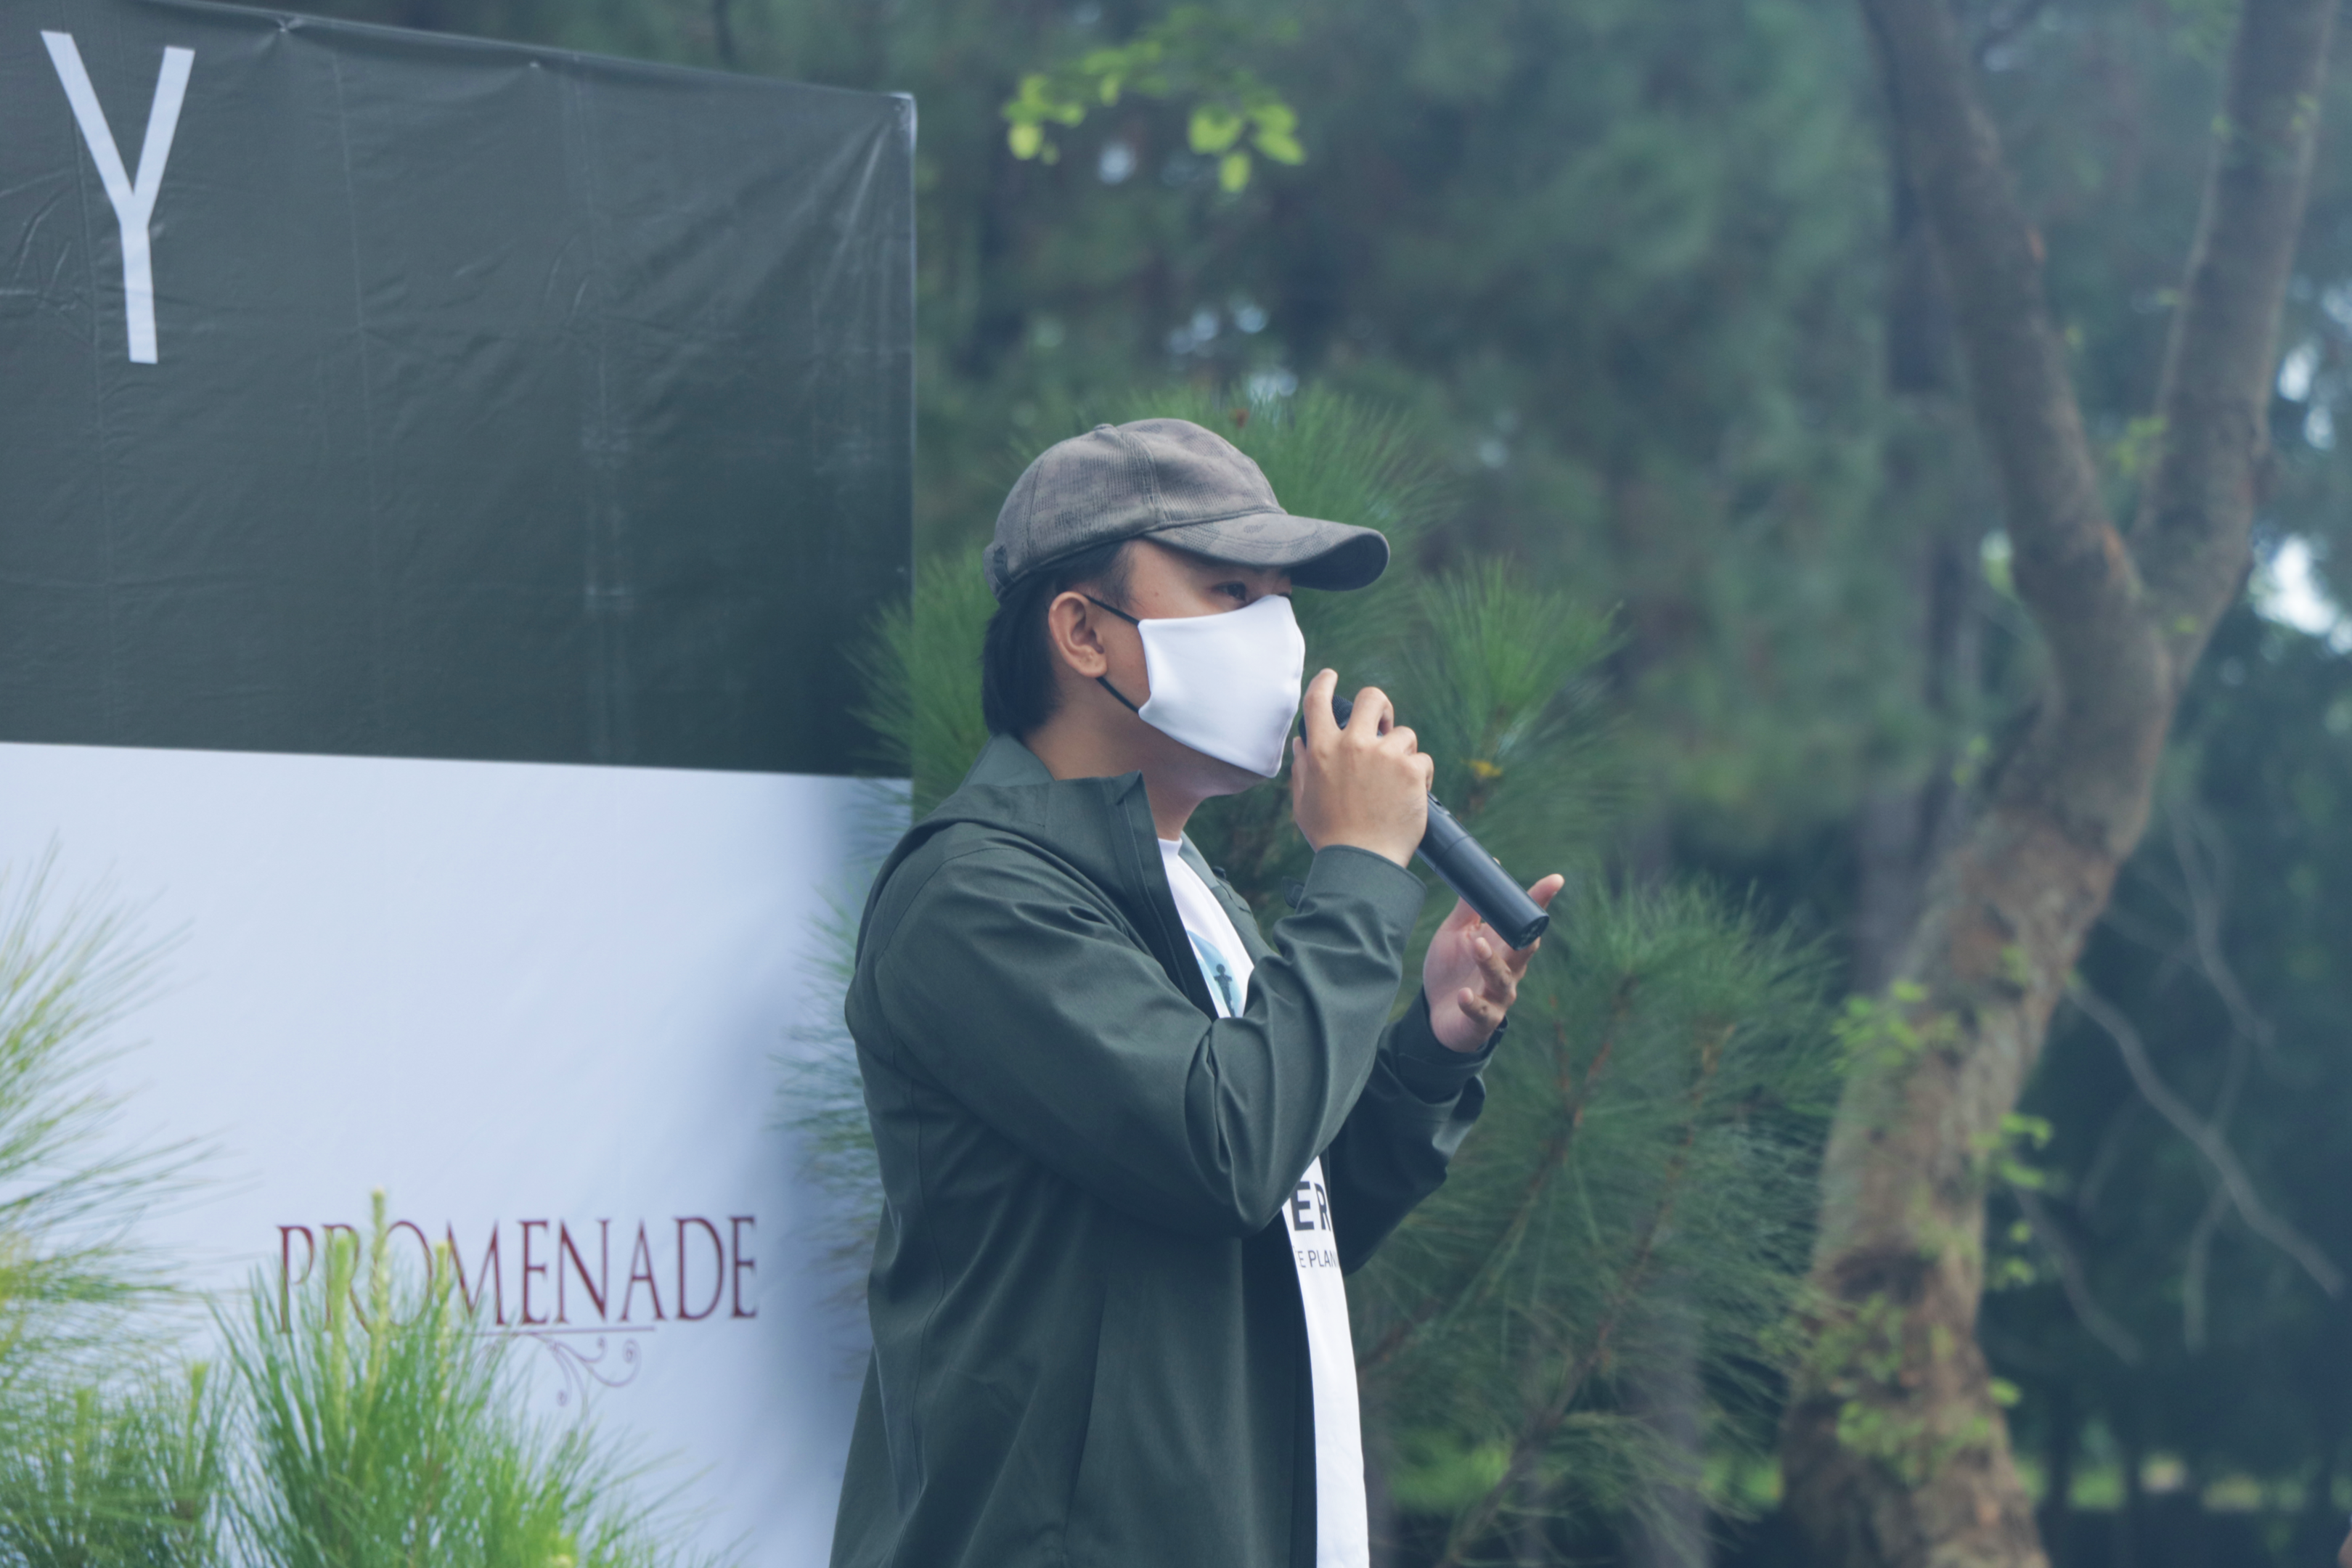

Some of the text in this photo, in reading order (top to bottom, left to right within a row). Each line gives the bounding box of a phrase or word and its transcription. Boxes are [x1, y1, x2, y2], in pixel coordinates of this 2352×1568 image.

[41, 30, 195, 364] Y
[277, 1215, 757, 1334] PROMENADE
[1294, 1249, 1307, 1268] E
